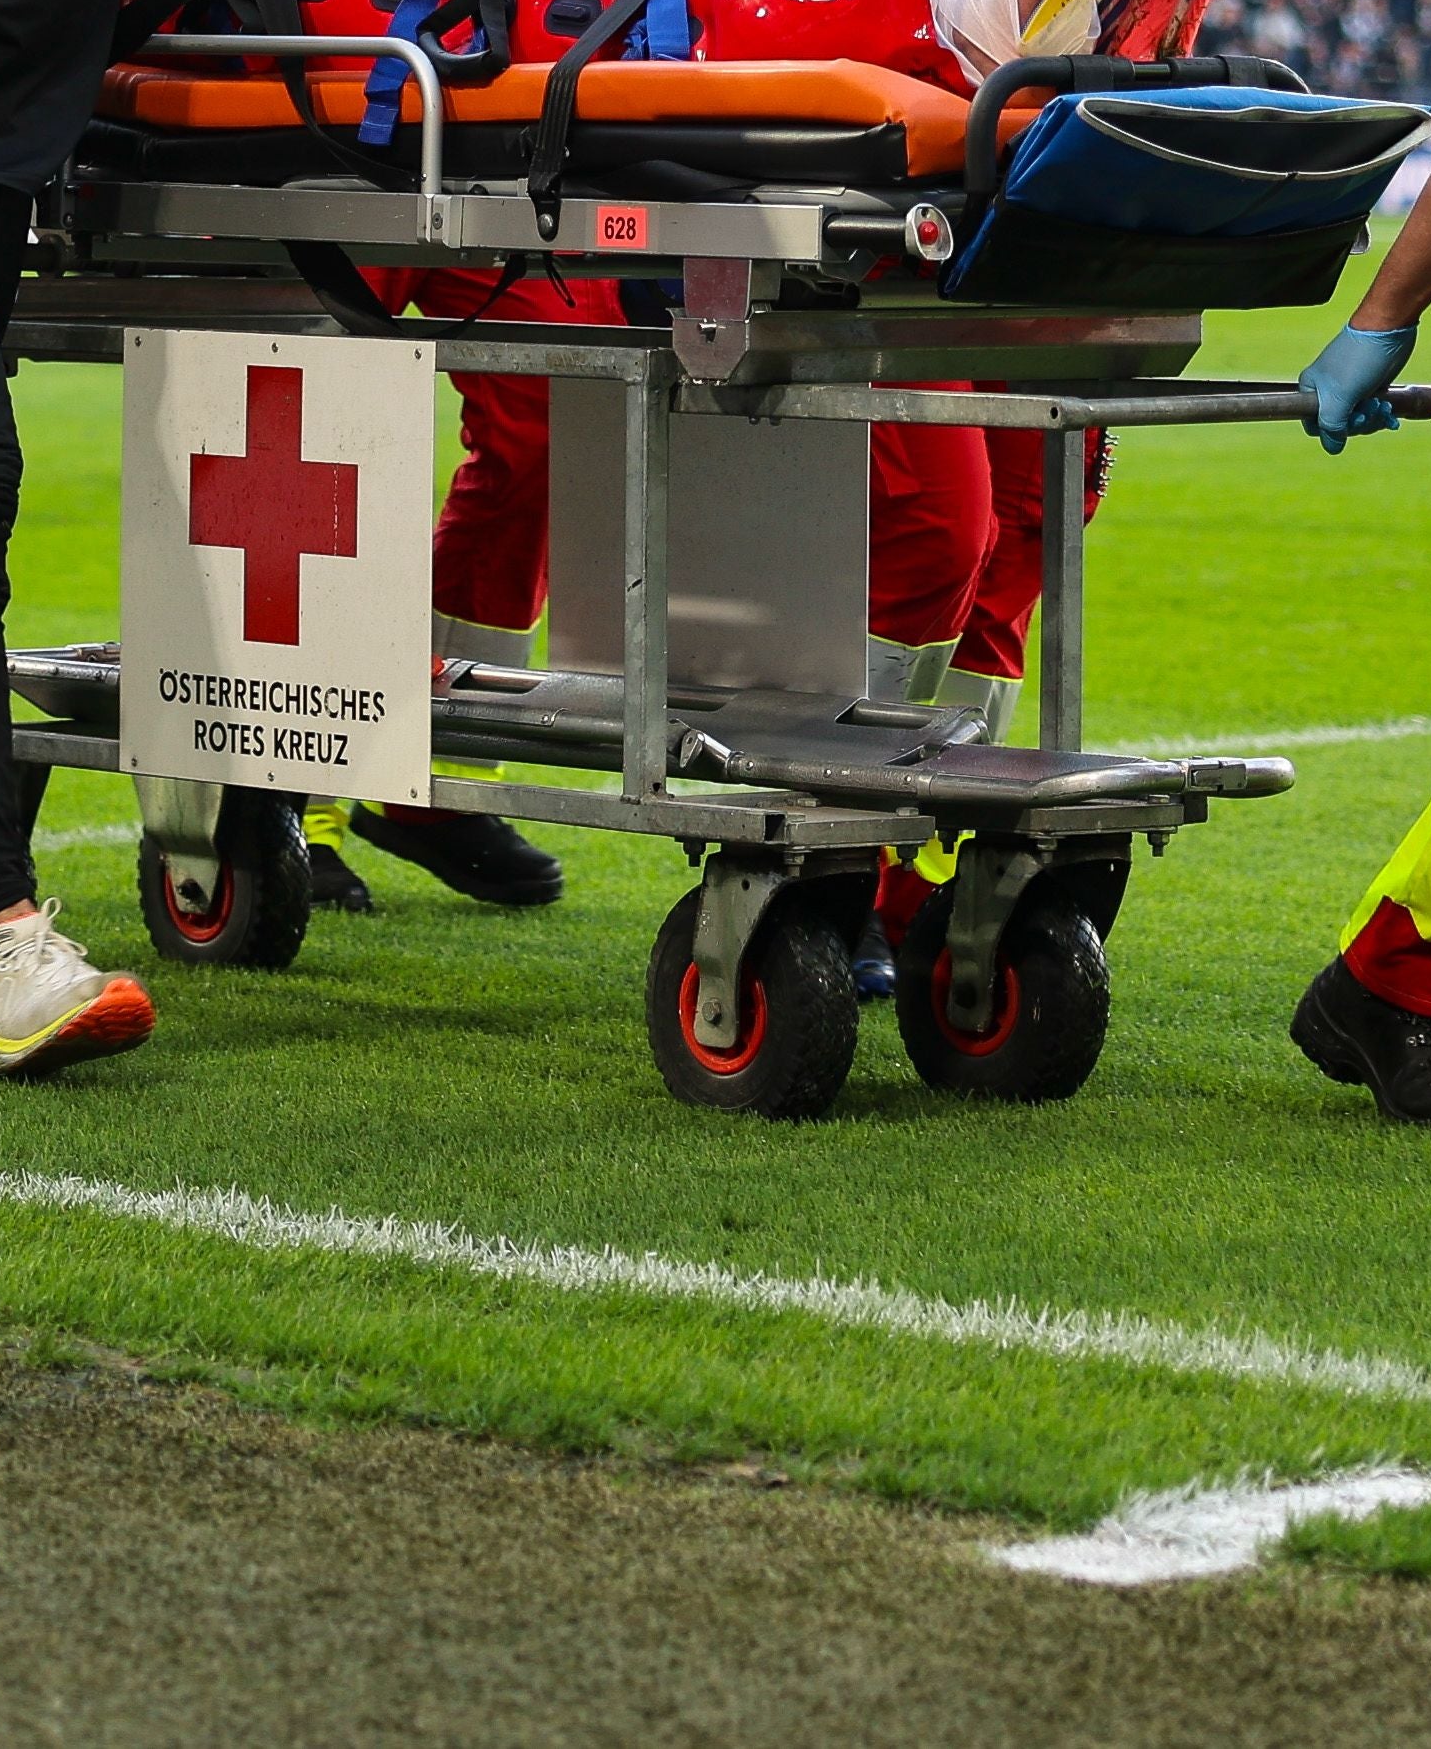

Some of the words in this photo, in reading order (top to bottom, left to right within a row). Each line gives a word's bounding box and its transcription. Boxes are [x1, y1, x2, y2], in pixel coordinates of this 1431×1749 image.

[604, 216, 637, 241] 628
[158, 667, 386, 724] ÖSTERREICHISCHES
[193, 718, 266, 757] ROTES
[272, 727, 350, 766] KREUZ
